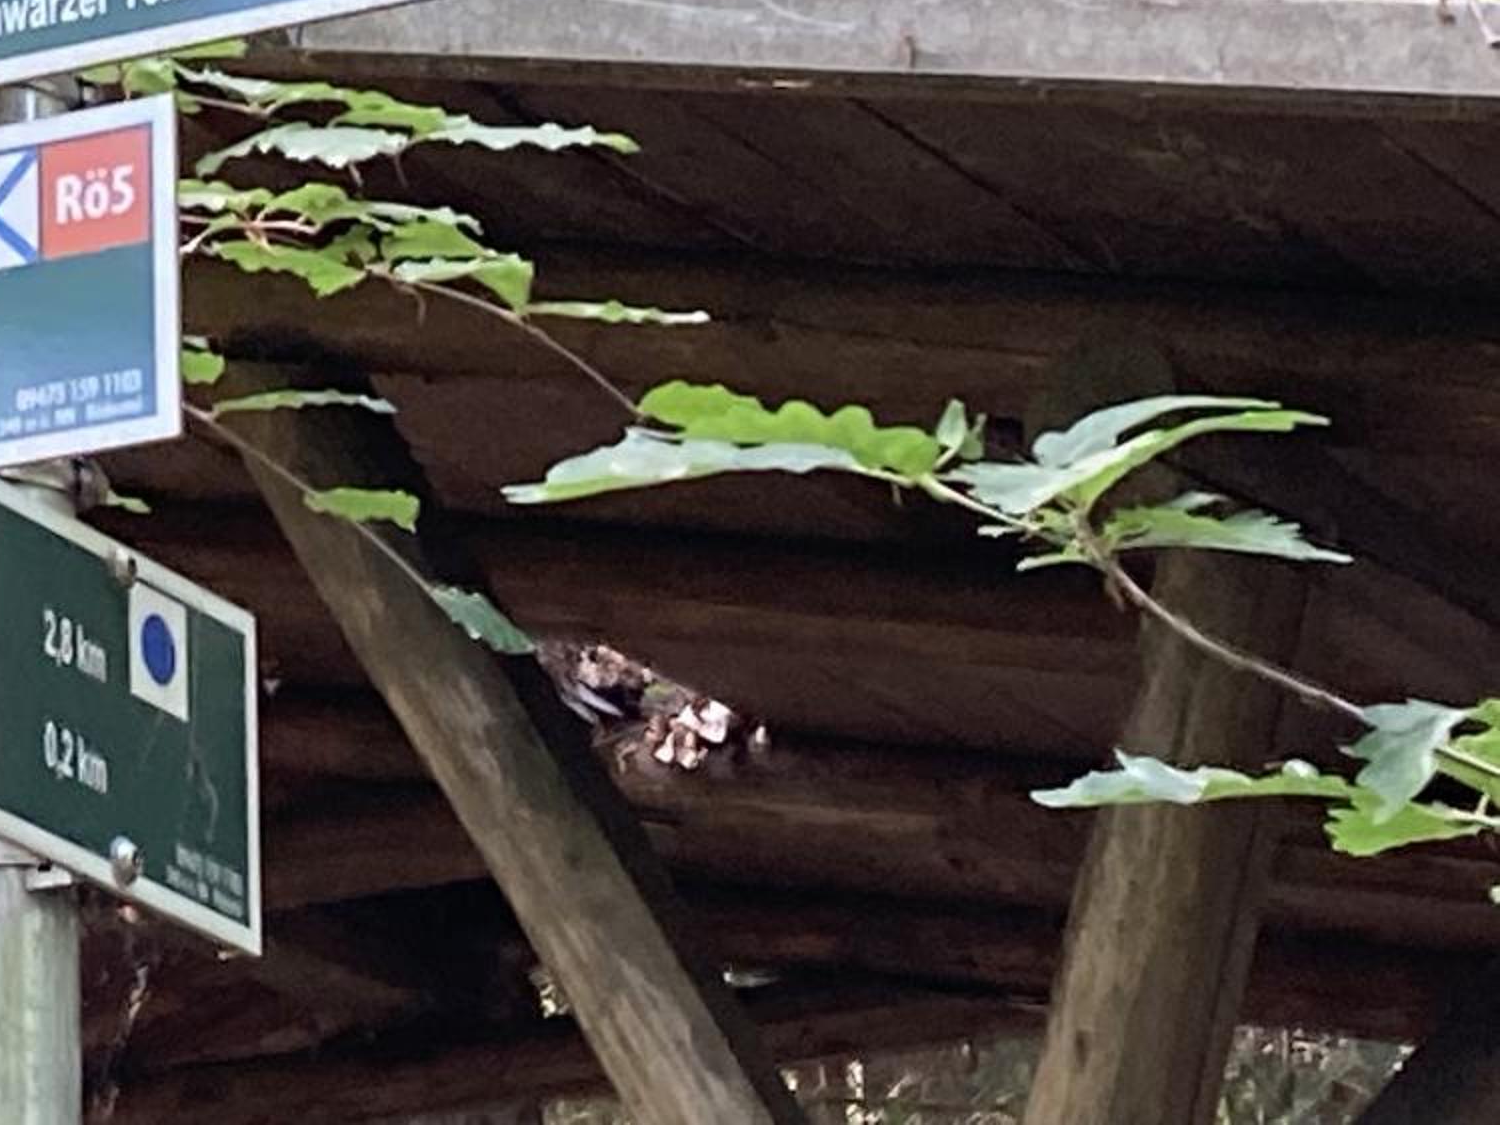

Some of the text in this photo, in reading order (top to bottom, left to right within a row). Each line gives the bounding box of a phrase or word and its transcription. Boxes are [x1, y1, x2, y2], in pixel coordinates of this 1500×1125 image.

[55, 164, 135, 225] Rö5
[43, 608, 108, 684] 2,8 km
[43, 719, 108, 795] 0,2 km
